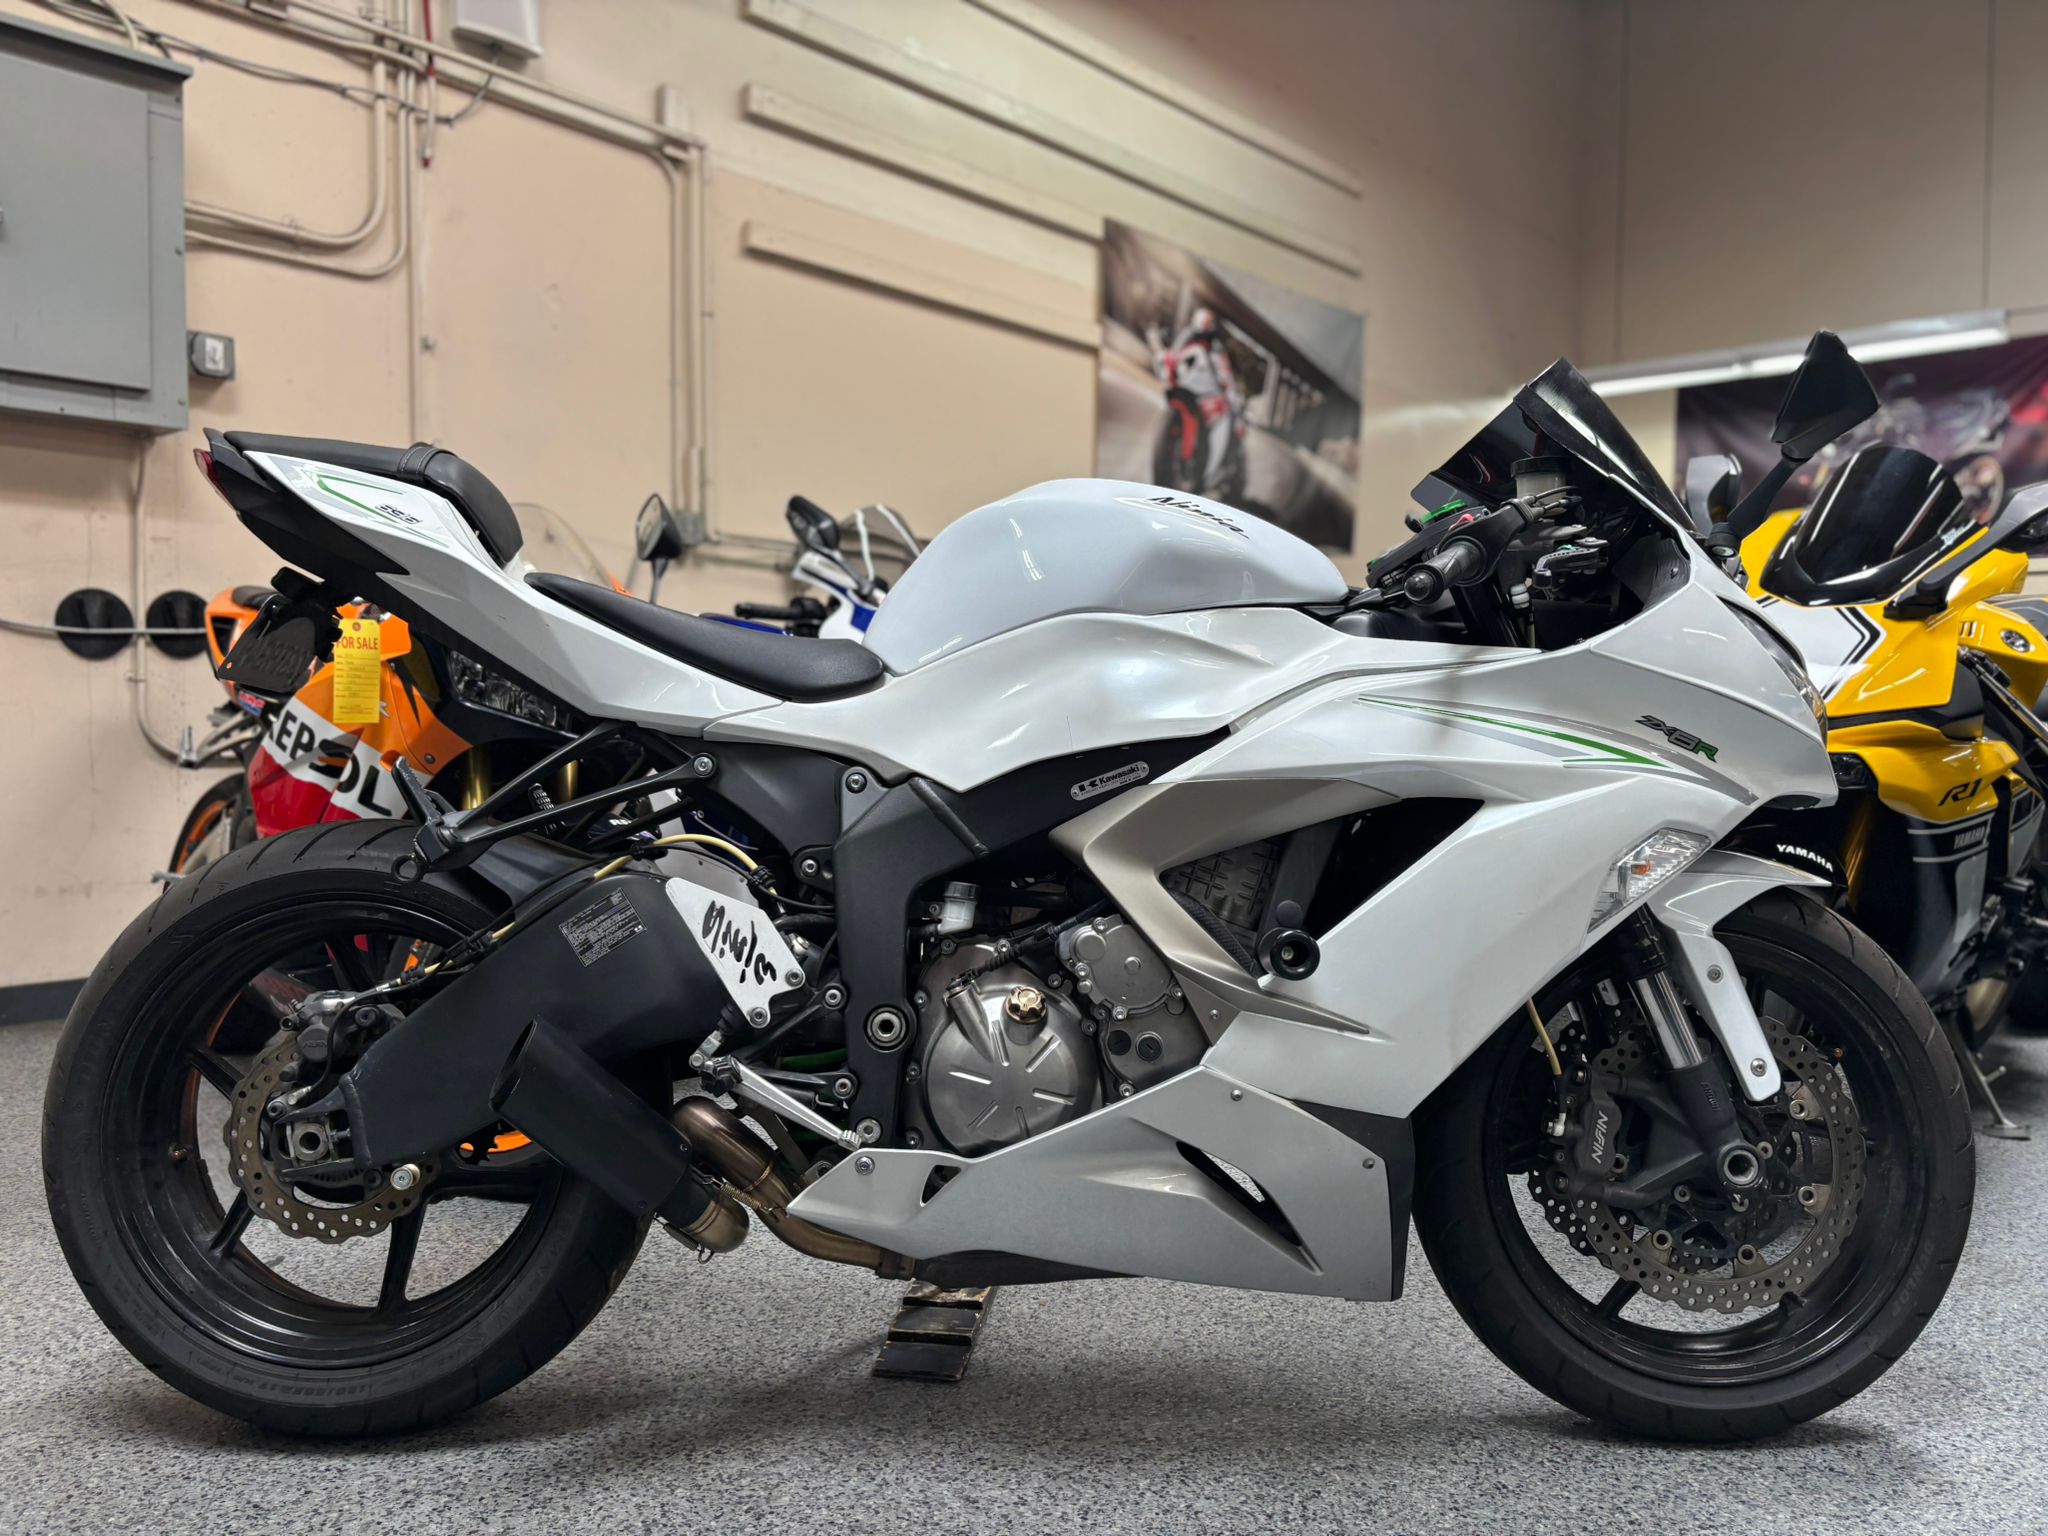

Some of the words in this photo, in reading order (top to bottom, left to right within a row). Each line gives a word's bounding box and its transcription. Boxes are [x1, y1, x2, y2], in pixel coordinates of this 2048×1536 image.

[1146, 496, 1249, 539] Ninja
[356, 637, 379, 650] SALE
[1634, 714, 1719, 763] ZX6R
[1099, 764, 1140, 785] Kawasaki
[1937, 777, 1983, 807] R1
[1776, 844, 1834, 873] YAMAHA
[1591, 1110, 1609, 1164] NISSIN
